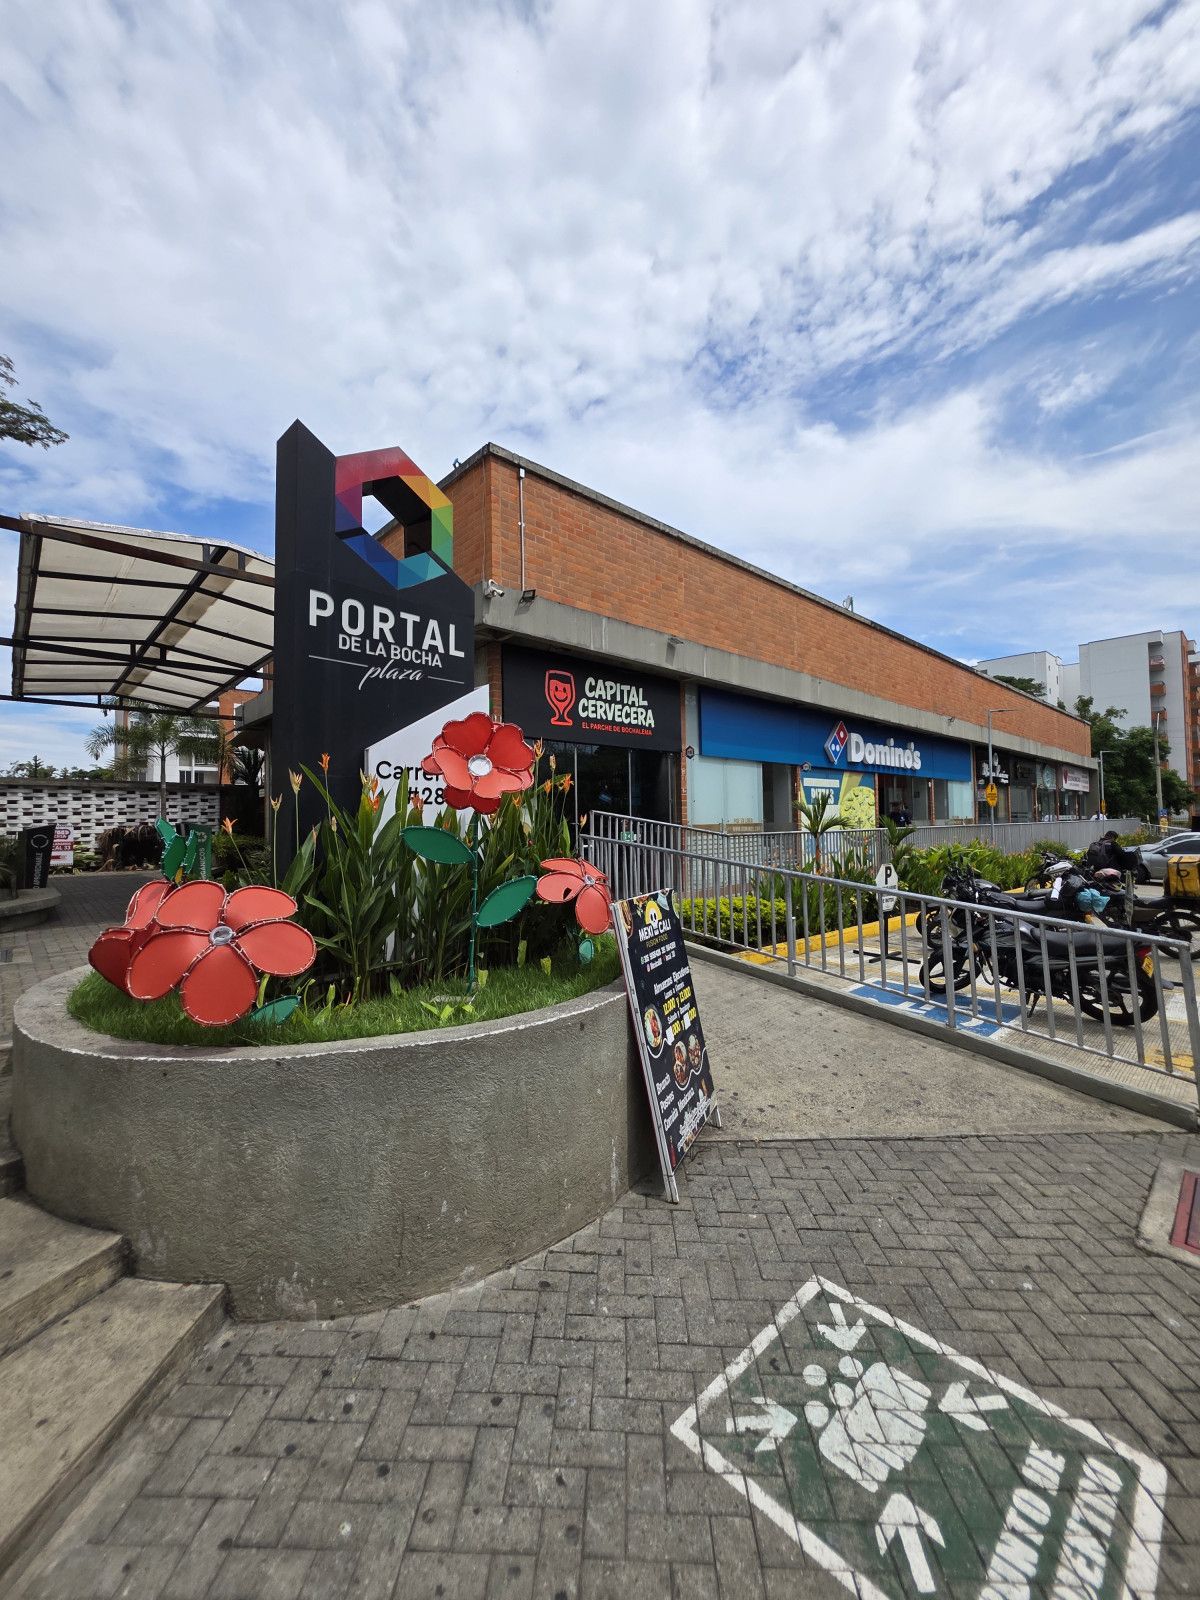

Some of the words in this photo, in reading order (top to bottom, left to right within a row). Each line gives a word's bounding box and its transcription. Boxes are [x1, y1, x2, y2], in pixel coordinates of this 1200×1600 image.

[309, 589, 464, 658] PORTAL
[338, 634, 362, 653] DE
[366, 639, 386, 658] LA
[390, 644, 442, 668] BOCHA
[358, 659, 424, 690] plaza
[584, 676, 648, 706] CAPITAL
[578, 698, 655, 728] CERVECERA
[590, 723, 612, 732] PARCHE
[847, 732, 921, 770] Domino's
[885, 866, 892, 885] P
[638, 925, 654, 942] MEXI
[658, 919, 671, 934] CALI
